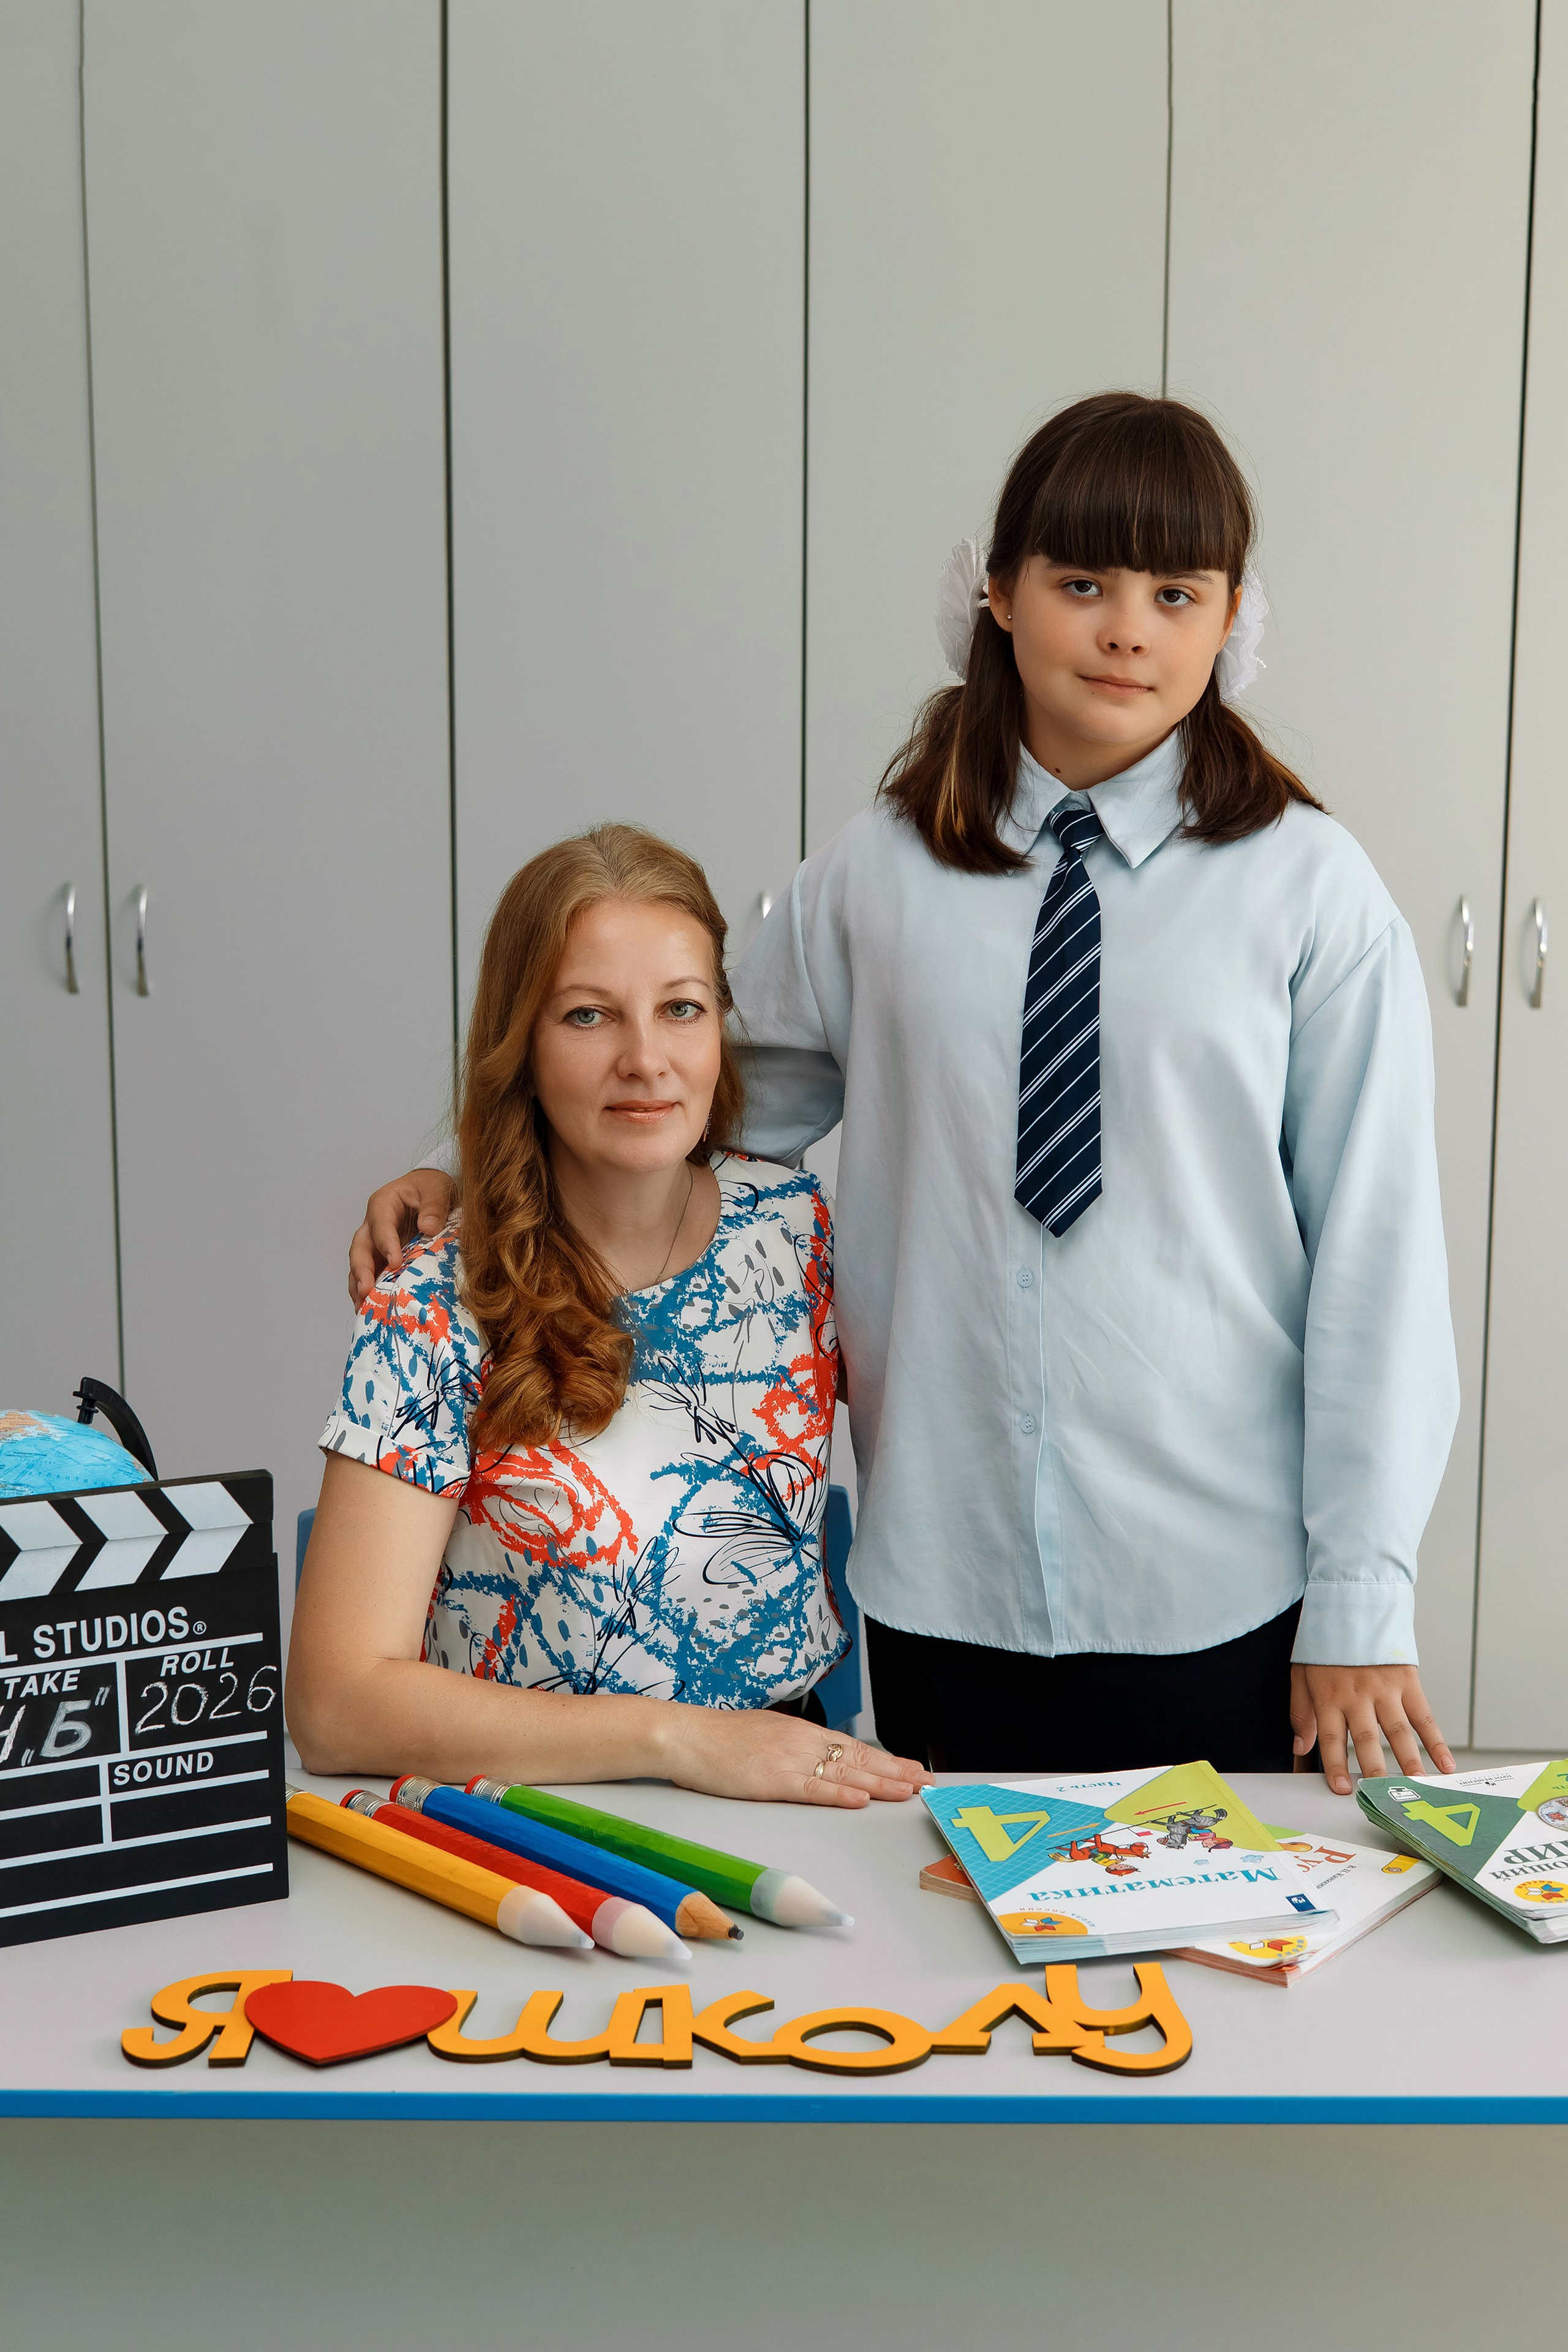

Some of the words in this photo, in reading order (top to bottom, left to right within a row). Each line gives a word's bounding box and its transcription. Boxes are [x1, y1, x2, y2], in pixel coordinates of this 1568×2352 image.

[160, 1647, 234, 1677] ROLL
[4, 1669, 80, 1700] TAKE
[134, 1665, 277, 1736] 2026
[113, 1751, 214, 1786] SOUND
[951, 1806, 1051, 1862] 4
[1401, 1800, 1481, 1847] 4
[1027, 1866, 1282, 1901] Математика
[121, 1969, 293, 2069] Я
